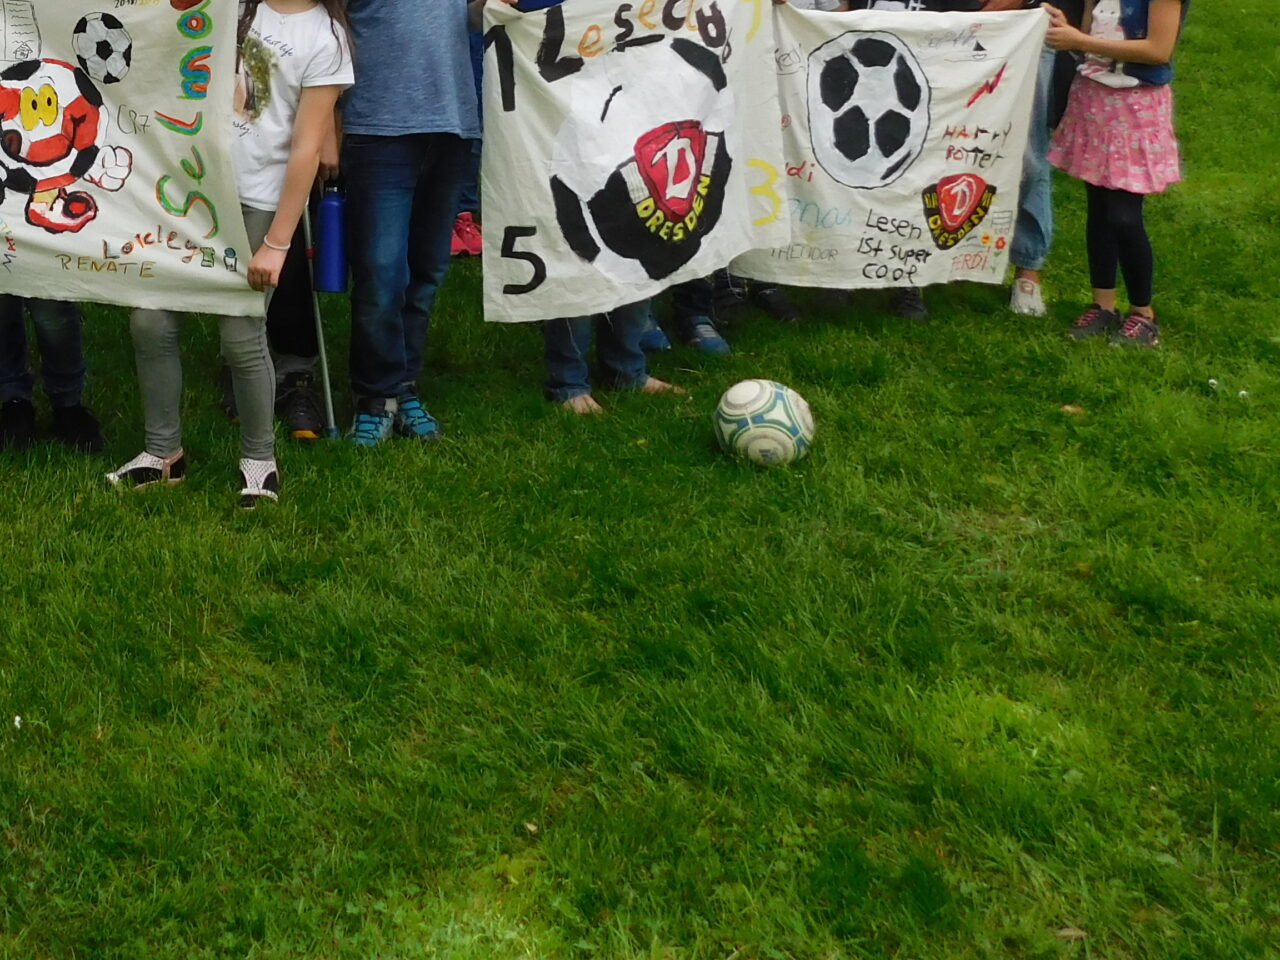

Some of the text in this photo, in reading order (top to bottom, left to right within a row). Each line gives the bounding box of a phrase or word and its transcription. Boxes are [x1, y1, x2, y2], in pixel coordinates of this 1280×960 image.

[635, 174, 711, 241] DRESDEN
[500, 158, 782, 295] 5 3
[865, 208, 923, 240] Lesen
[55, 253, 158, 278] RENATE
[888, 245, 933, 264] super
